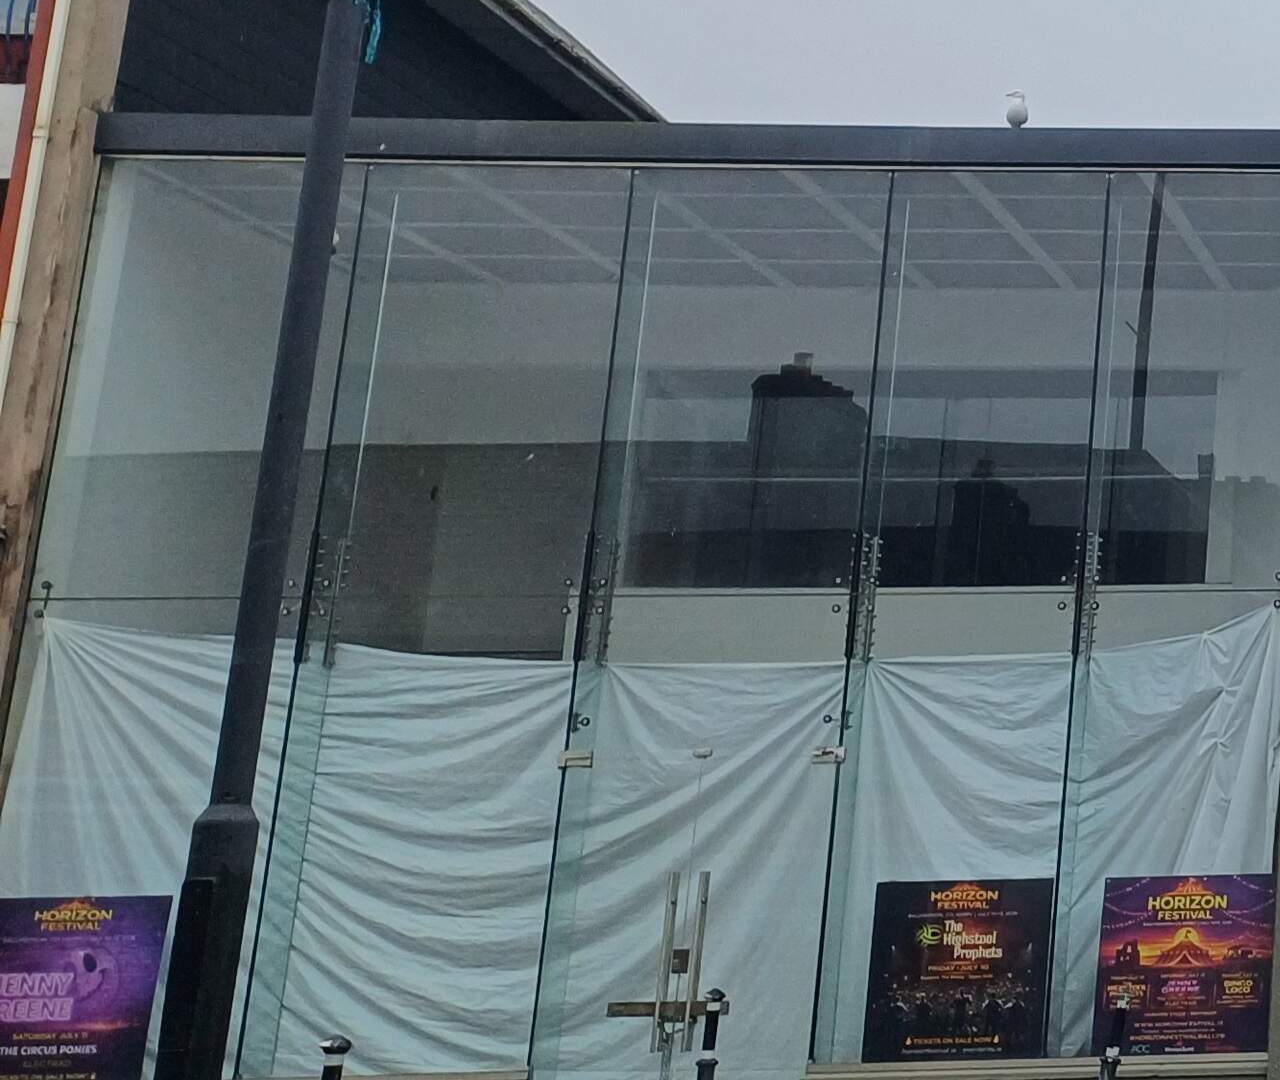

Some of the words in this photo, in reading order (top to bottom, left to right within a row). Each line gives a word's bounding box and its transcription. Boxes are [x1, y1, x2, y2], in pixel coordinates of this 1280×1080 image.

[931, 891, 999, 902] HORIZON
[1148, 894, 1228, 910] HORIZON
[937, 901, 989, 909] FESTIVAL
[34, 910, 112, 920] HORIZON
[1158, 910, 1213, 920] FESTIVAL
[41, 922, 101, 932] FESTIVAL
[944, 920, 963, 932] The
[943, 931, 996, 946] Highstool
[954, 945, 1002, 960] Prophets
[0, 973, 74, 997] ENNY
[20, 1045, 57, 1055] CIRCUS
[59, 1044, 97, 1054] PONIES
